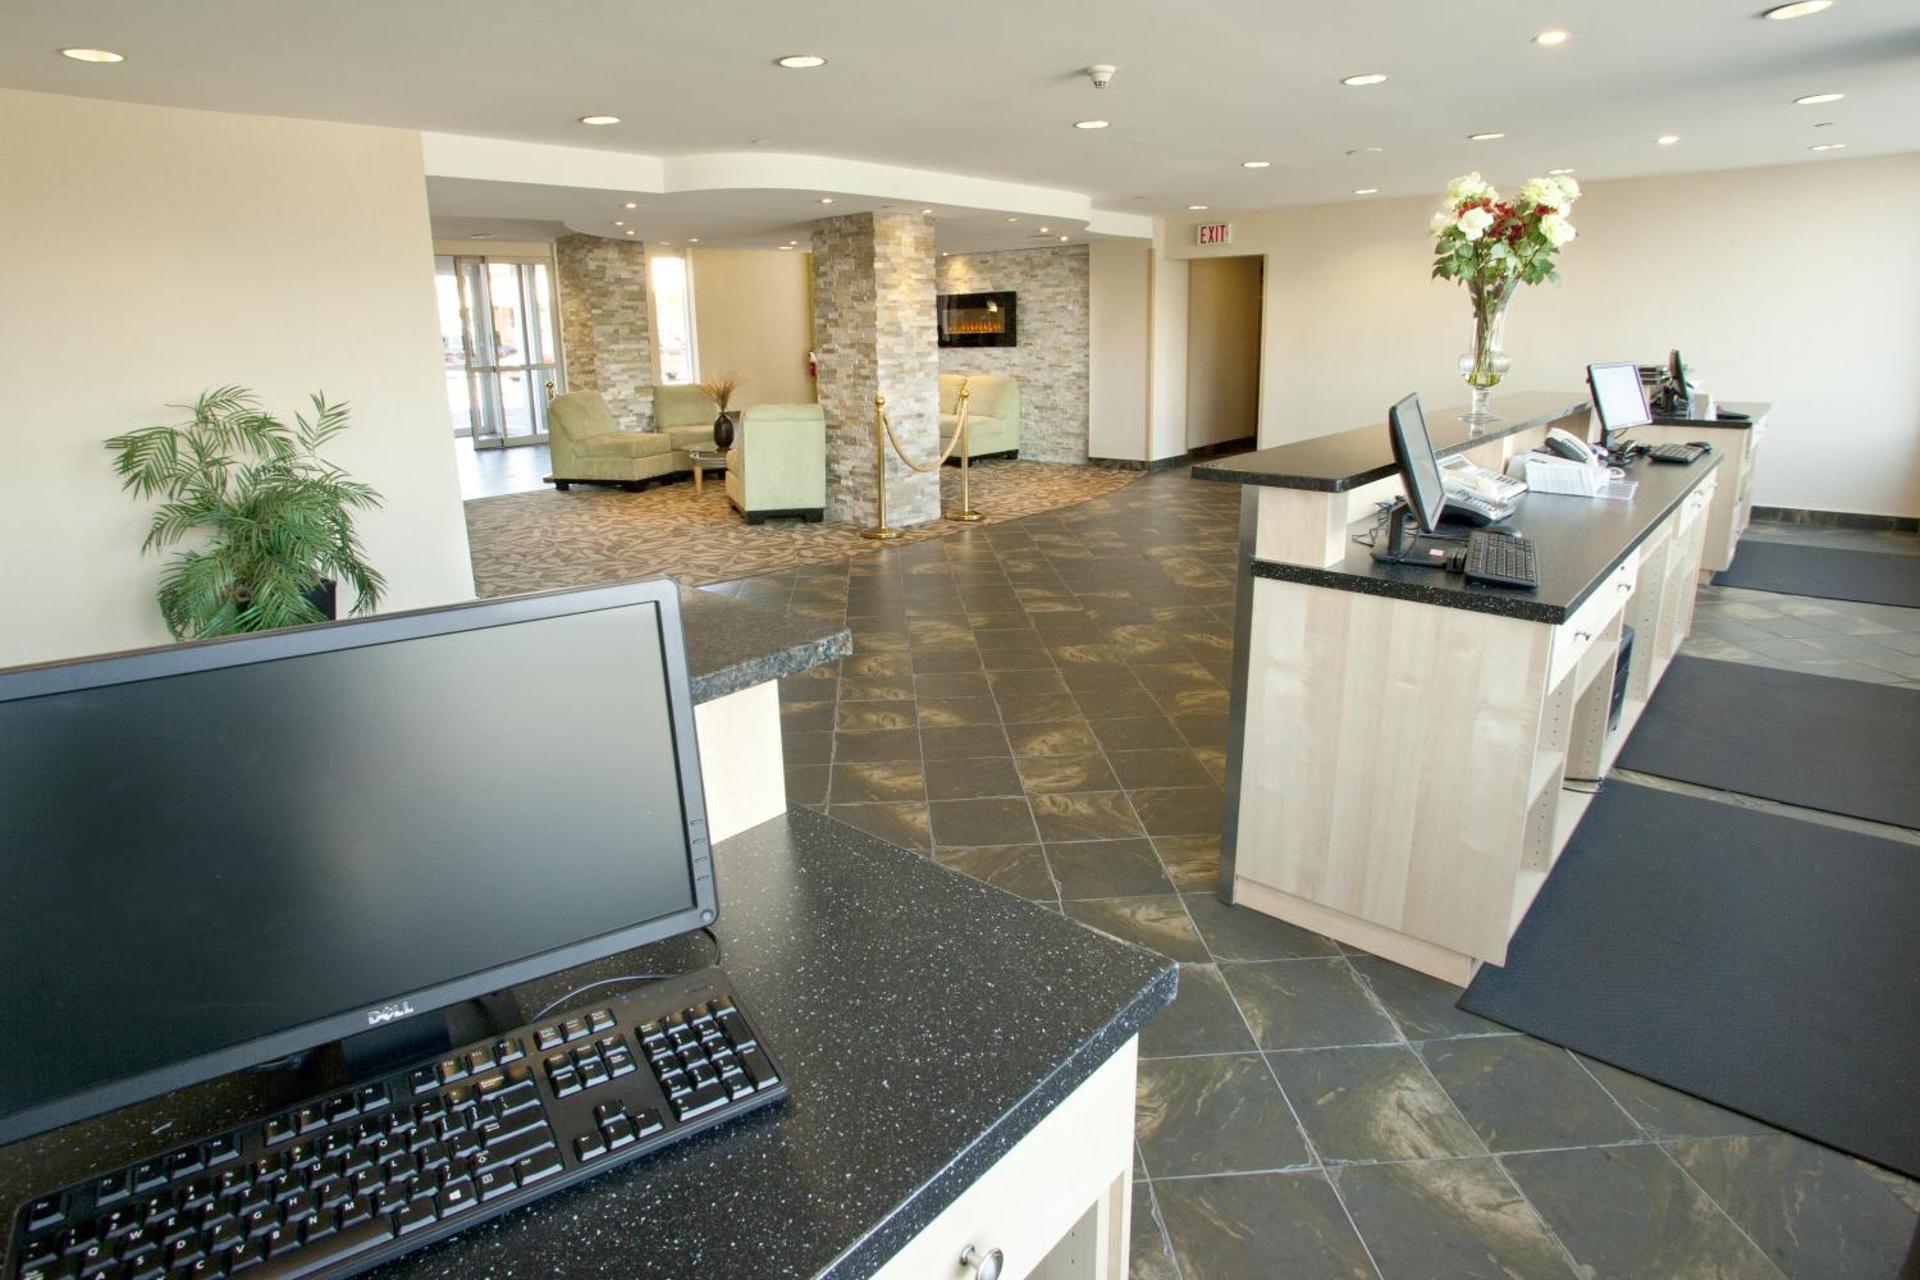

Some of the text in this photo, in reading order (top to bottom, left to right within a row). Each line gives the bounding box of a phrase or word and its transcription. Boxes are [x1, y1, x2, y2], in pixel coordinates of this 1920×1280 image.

[1200, 224, 1226, 244] EXIT
[368, 1001, 414, 1025] DELL
[312, 1163, 321, 1171] U
[391, 1160, 398, 1168] L
[280, 1175, 287, 1184] Y
[358, 1171, 366, 1179] K
[289, 1197, 298, 1206] H
[344, 1201, 355, 1212] M
[168, 1217, 175, 1227] E
[309, 1215, 318, 1225] N
[129, 1229, 143, 1241] W
[215, 1225, 223, 1235] F
[235, 1244, 245, 1254] V
[136, 1256, 144, 1266] S
[195, 1260, 205, 1270] C
